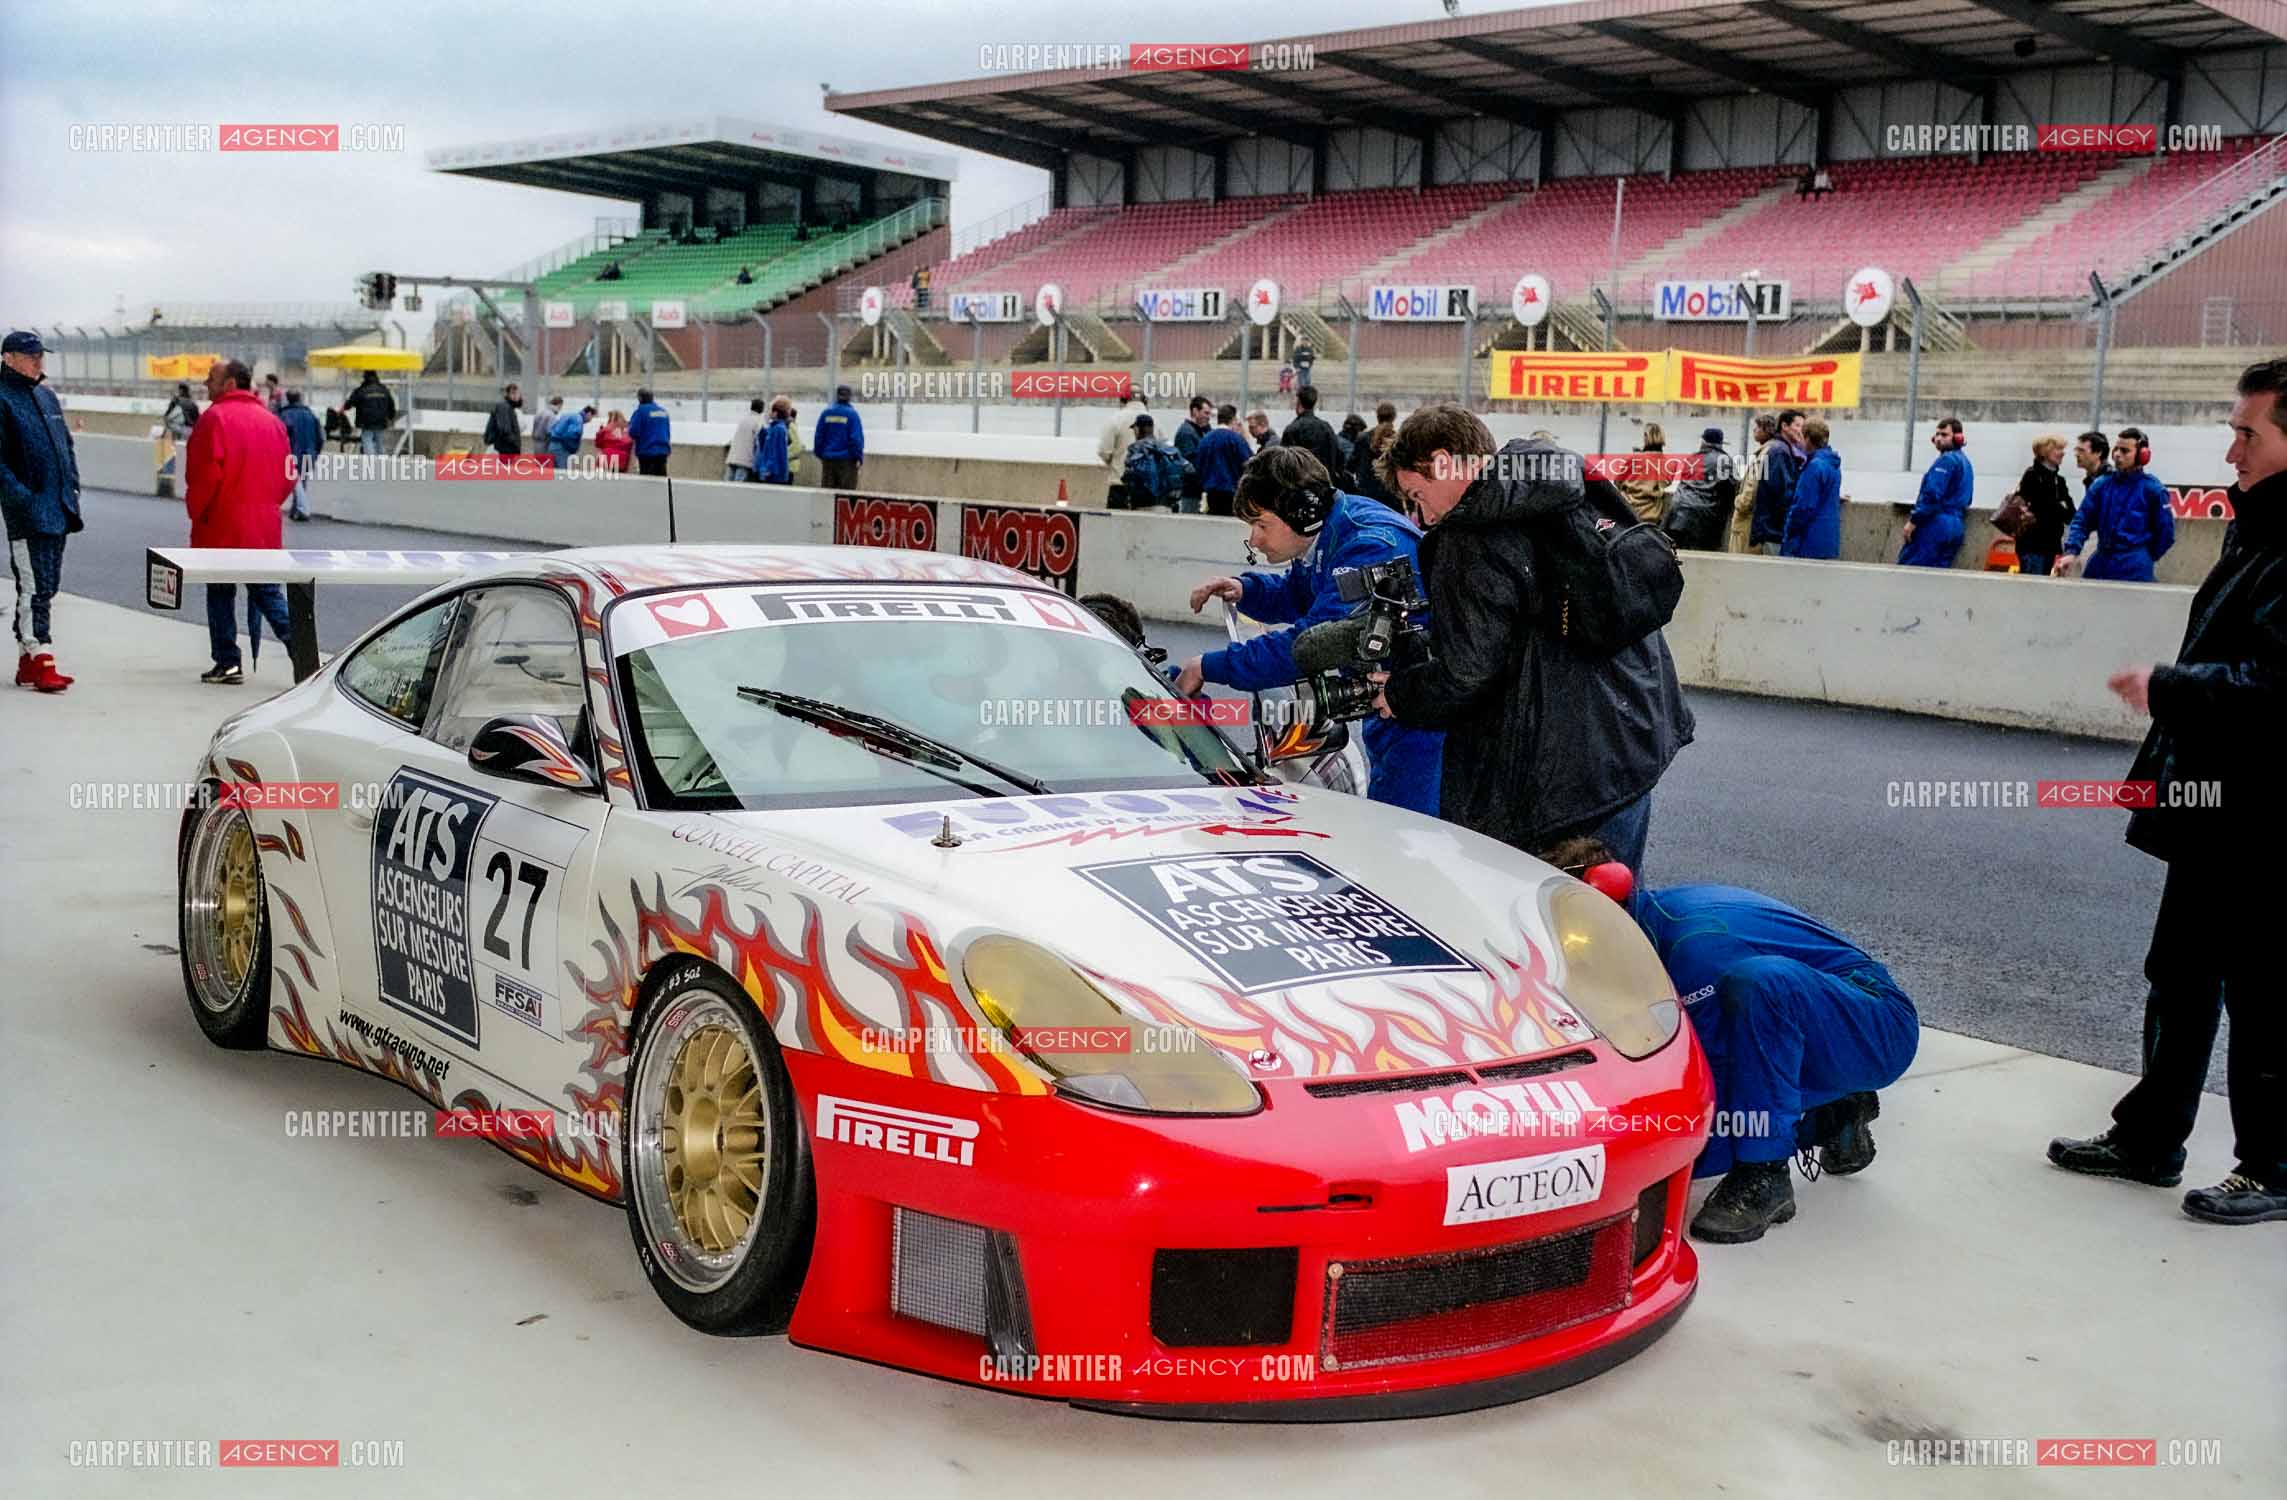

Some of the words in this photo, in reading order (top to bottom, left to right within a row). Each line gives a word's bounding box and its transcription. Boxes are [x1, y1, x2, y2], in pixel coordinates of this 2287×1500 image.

[1374, 289, 1438, 317] Mobil
[1759, 285, 1776, 314] 1
[1510, 355, 1649, 399] PIRELLI
[1681, 355, 1838, 403] PIRELLI
[836, 498, 936, 551] MOTO
[964, 507, 1077, 575] MOTO
[751, 590, 1016, 622] PIRELLI
[387, 788, 469, 881] ATS
[377, 864, 463, 937] ASCENSEURS
[766, 854, 870, 904] CAPITAL
[1149, 857, 1319, 903] ATS
[484, 851, 549, 971] 27
[1166, 891, 1384, 932] ASCENSEURS
[1193, 924, 1279, 955] SUR
[1274, 914, 1420, 944] MESURE
[378, 907, 407, 955] SUR
[410, 919, 469, 984] MESURE
[1285, 940, 1392, 971] PARIS
[407, 962, 447, 1016] PARIS
[339, 1009, 450, 1081] www.gtracing.net
[816, 1094, 980, 1166] PIRELLI
[1394, 1080, 1607, 1153] MOTUL
[1458, 1153, 1601, 1213] ACTEON
